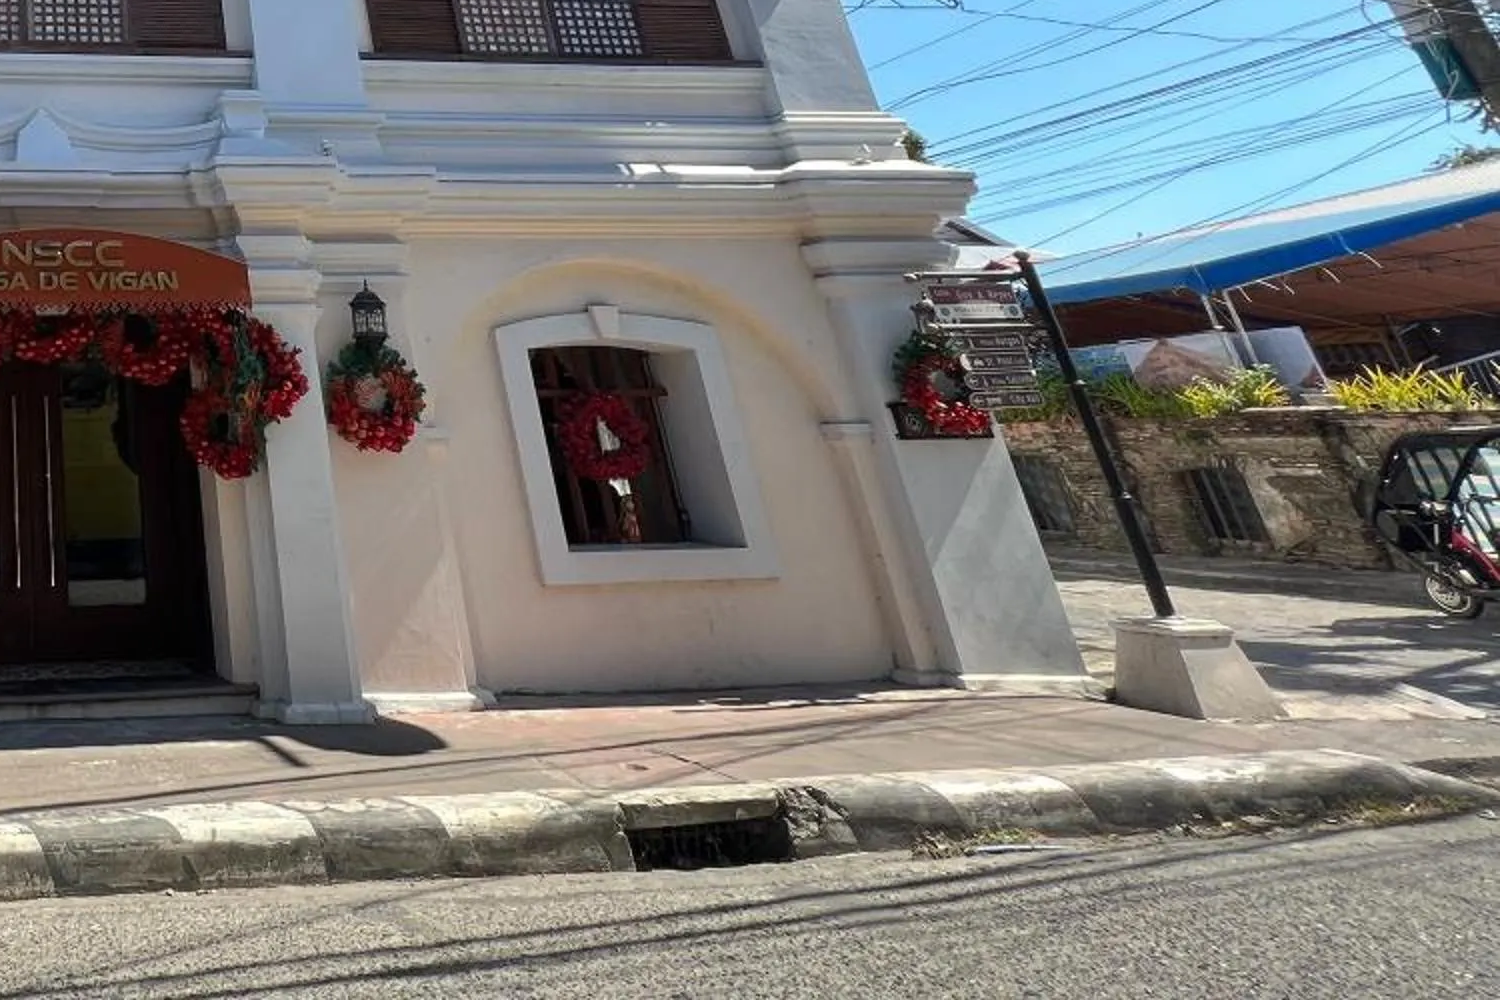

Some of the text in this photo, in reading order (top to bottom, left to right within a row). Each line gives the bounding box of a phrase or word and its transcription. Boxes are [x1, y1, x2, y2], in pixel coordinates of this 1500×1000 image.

[1, 238, 125, 267] NSCC
[39, 270, 79, 291] DE
[87, 270, 180, 291] VIGAN
